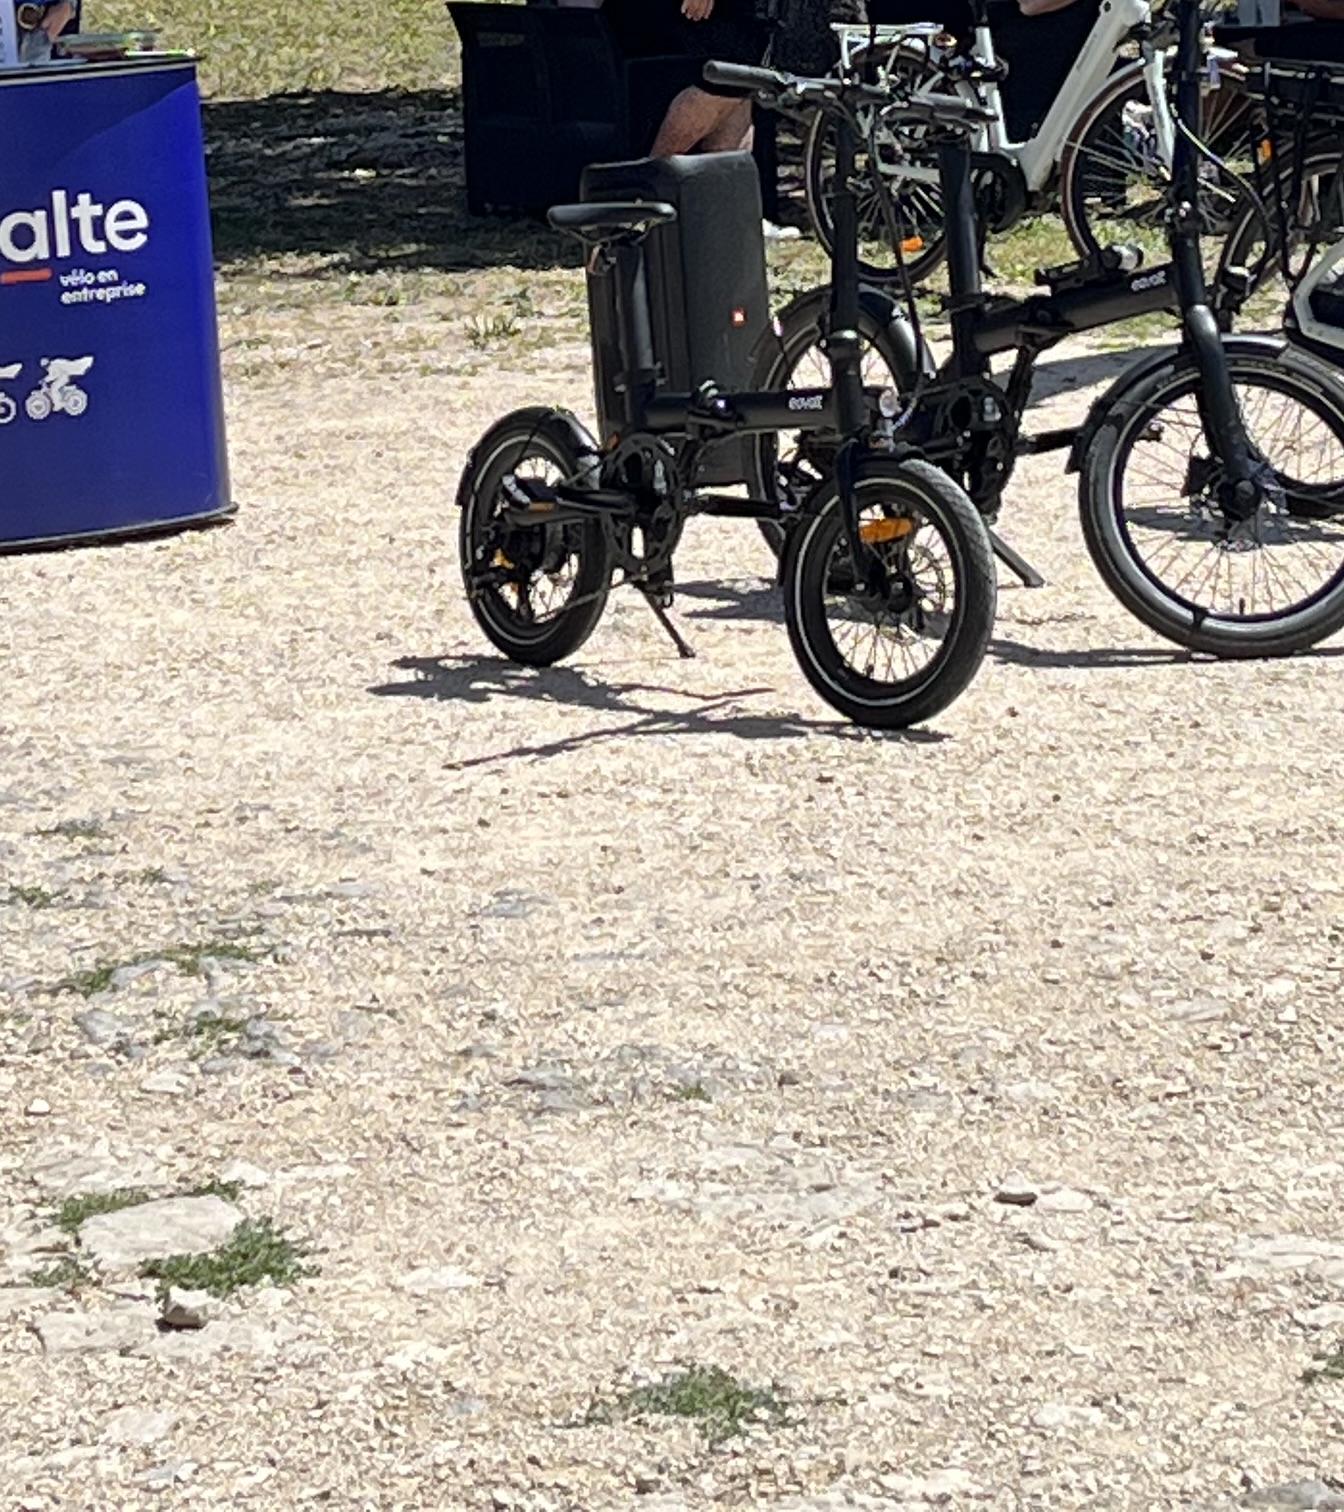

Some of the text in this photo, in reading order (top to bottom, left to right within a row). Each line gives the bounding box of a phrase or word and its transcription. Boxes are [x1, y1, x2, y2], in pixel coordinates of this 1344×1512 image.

[60, 268, 119, 287] vélo en
[60, 280, 147, 304] entreprise
